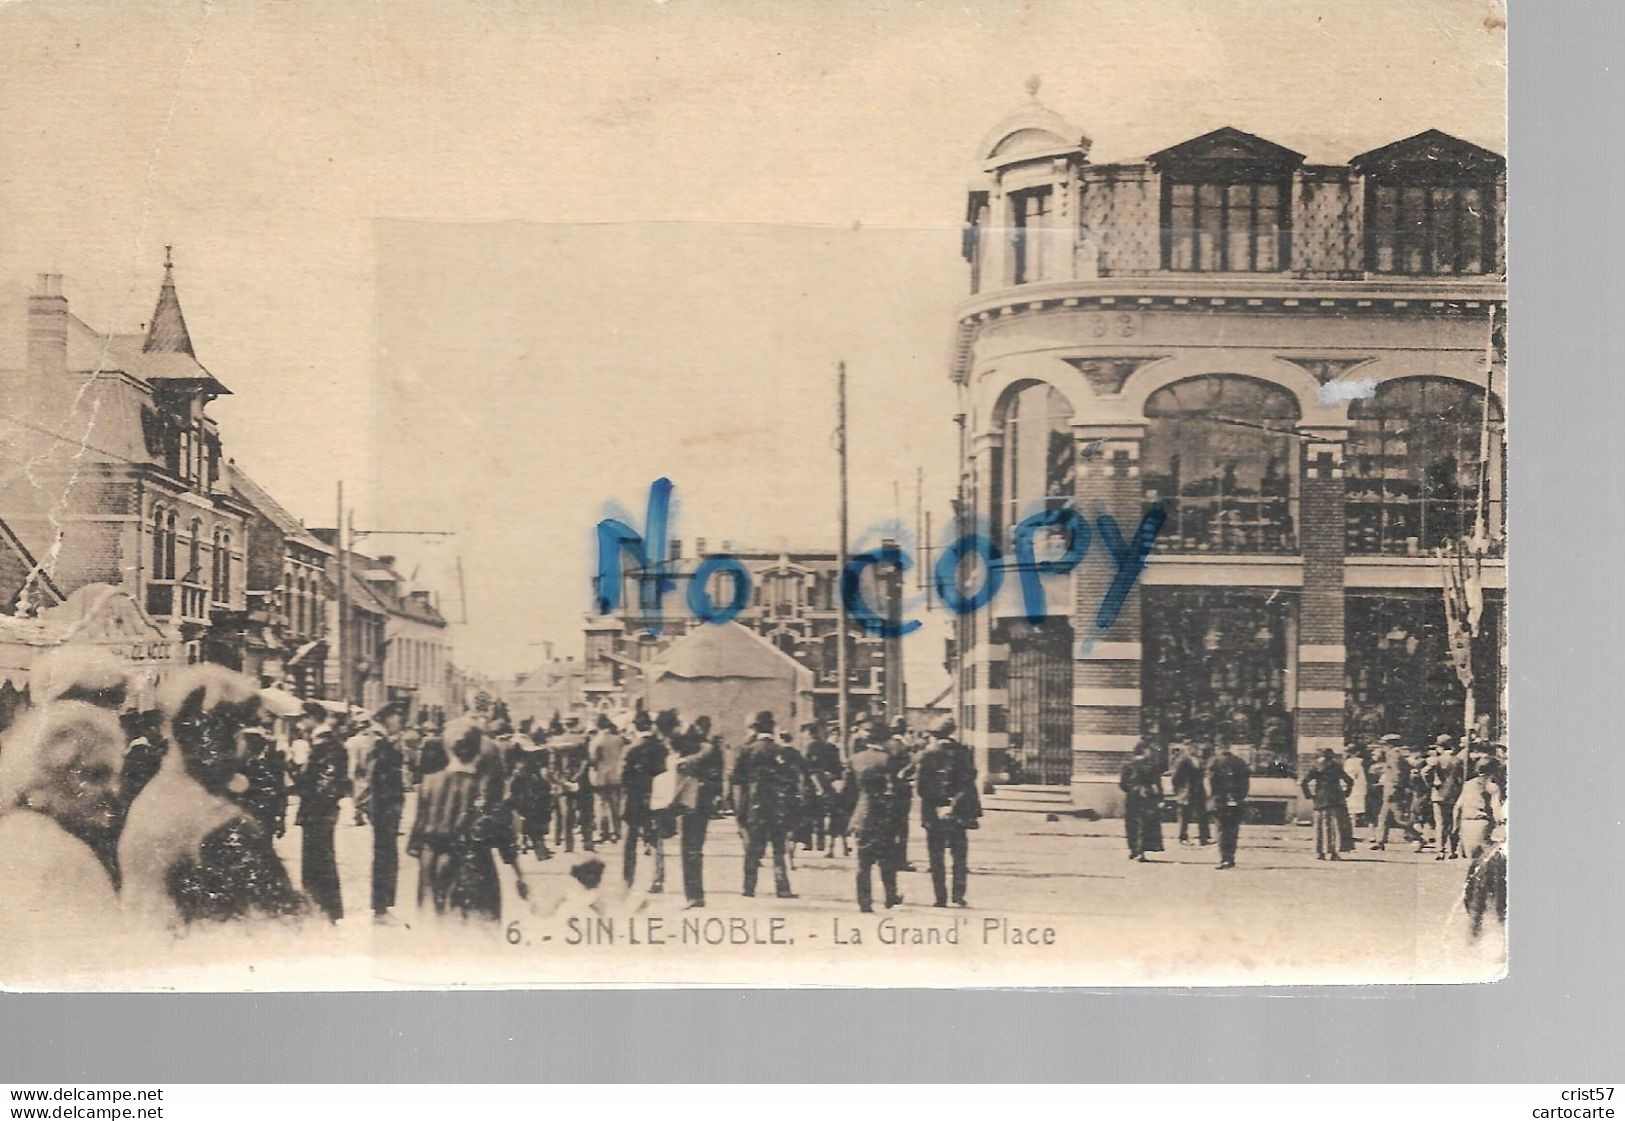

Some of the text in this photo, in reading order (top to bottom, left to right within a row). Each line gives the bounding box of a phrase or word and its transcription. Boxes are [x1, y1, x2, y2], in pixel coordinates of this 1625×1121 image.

[594, 477, 751, 638] No
[564, 917, 795, 945] SIN-LE-NOBLE.
[833, 917, 863, 945] La
[877, 917, 968, 945] Grand'
[982, 917, 1057, 945] Place
